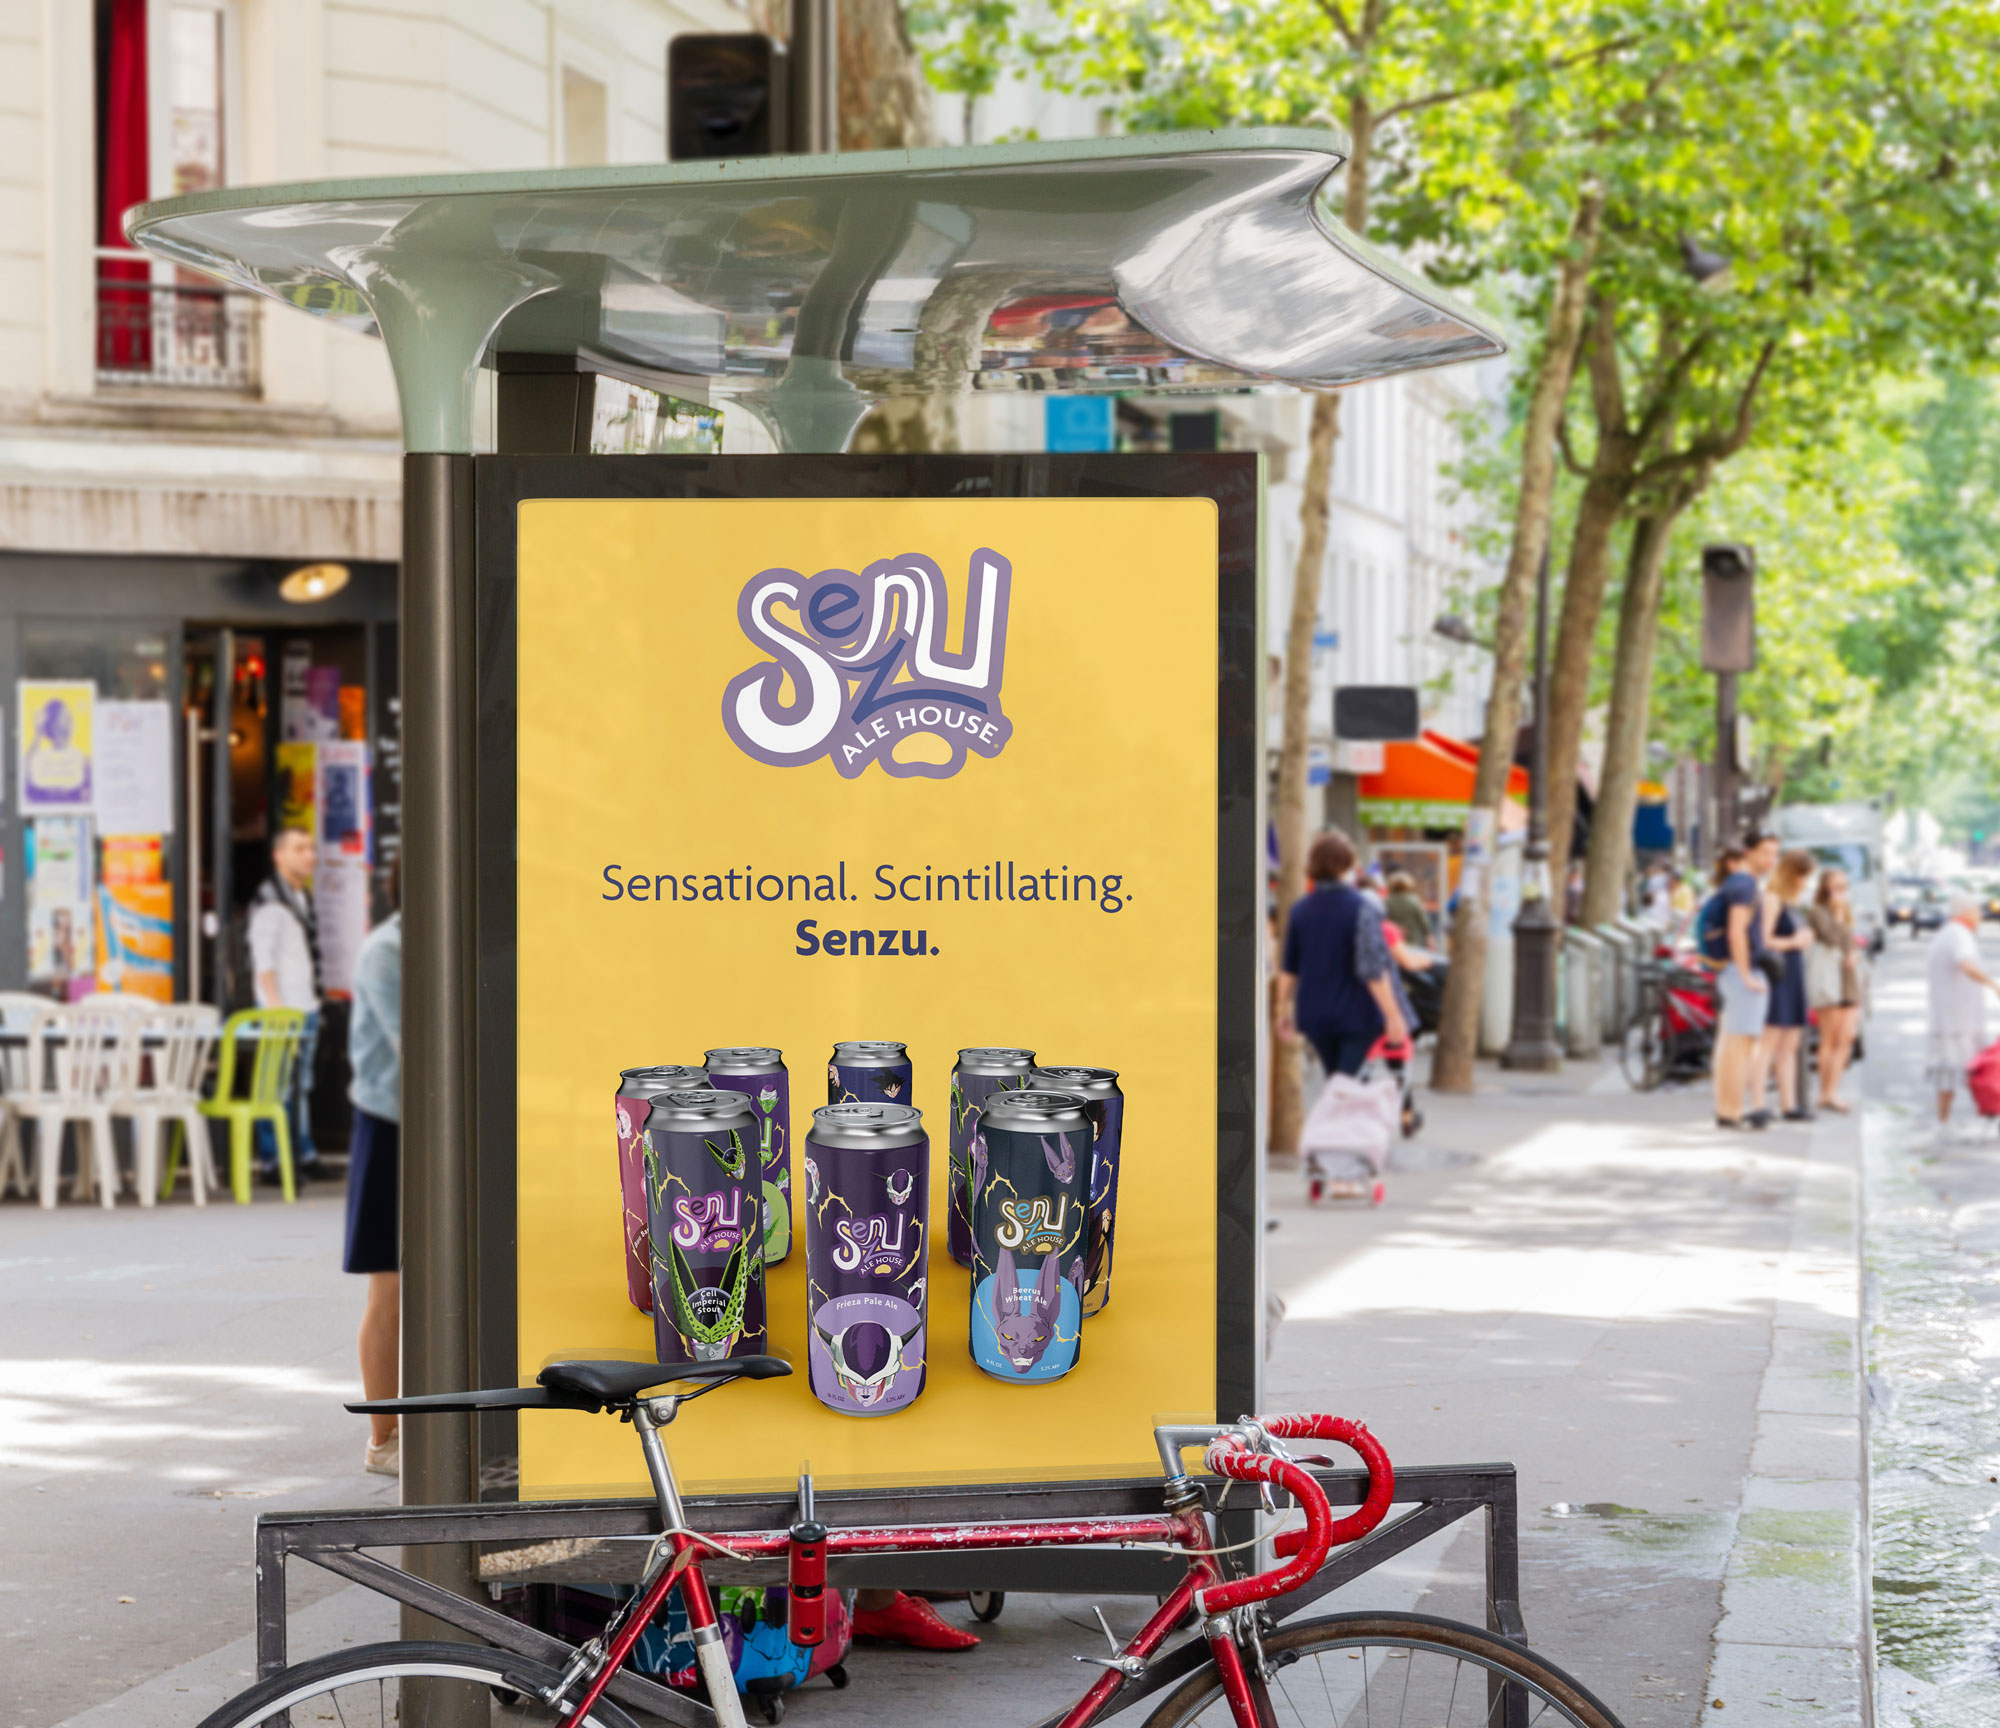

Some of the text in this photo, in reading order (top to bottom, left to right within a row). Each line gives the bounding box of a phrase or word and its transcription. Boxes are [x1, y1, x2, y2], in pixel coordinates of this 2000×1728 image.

[842, 705, 999, 765] ALE HOUSE
[602, 861, 1134, 914] Sensational. Scintillating.
[795, 919, 940, 956] Senzu.
[700, 1231, 741, 1250] ALE HOUSE
[1022, 1235, 1064, 1252] ALE HOUSE
[860, 1256, 904, 1275] ALE HOUSE
[700, 1289, 717, 1297] Cell
[1012, 1287, 1041, 1296] Beerus
[692, 1297, 726, 1309] Imperial
[836, 1296, 898, 1311] Frieza Pale Ale
[1005, 1294, 1048, 1306] Wheat Ale
[697, 1305, 721, 1315] Stout
